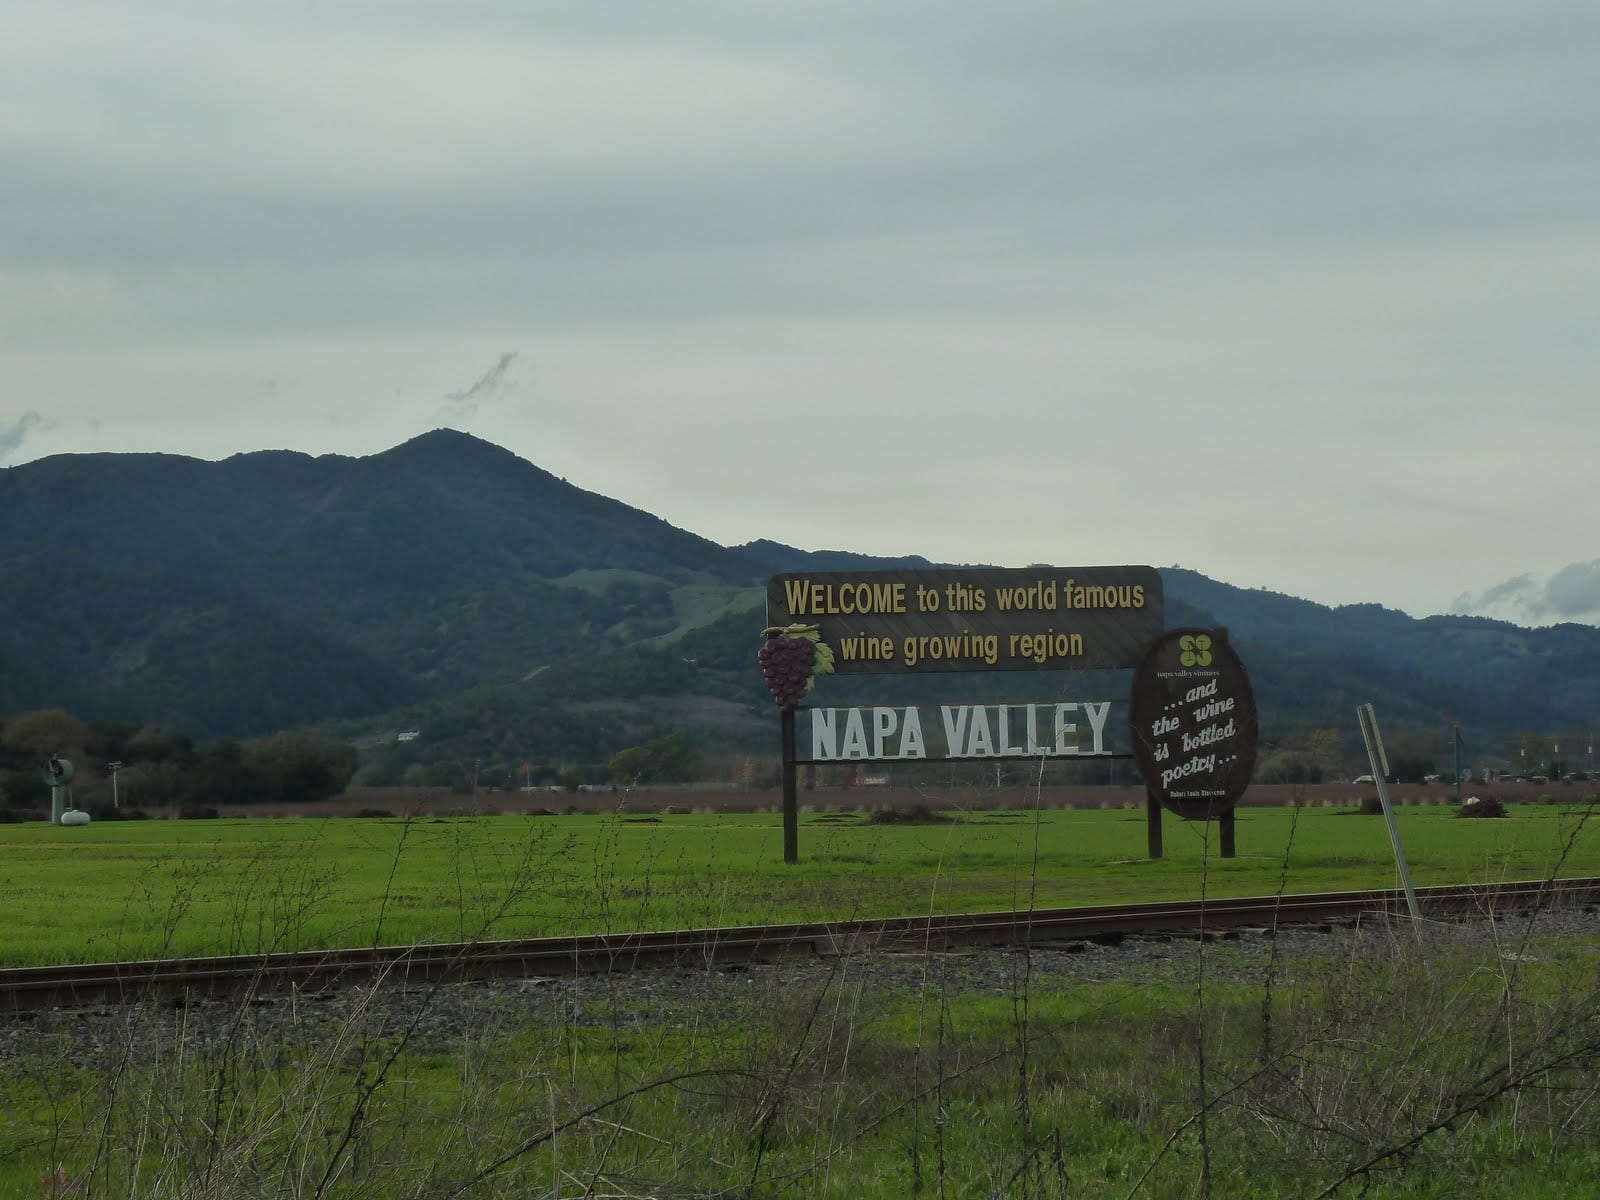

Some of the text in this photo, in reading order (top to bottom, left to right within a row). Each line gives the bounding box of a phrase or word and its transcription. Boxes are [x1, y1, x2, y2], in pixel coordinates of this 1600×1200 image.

[785, 579, 1145, 615] WELCOME to this world famous
[841, 628, 1083, 666] wine growing region
[1174, 669, 1192, 678] valley
[812, 702, 1113, 760] NAPA VALLEY
[1151, 697, 1235, 737] the wine
[1153, 718, 1237, 762] is bottled
